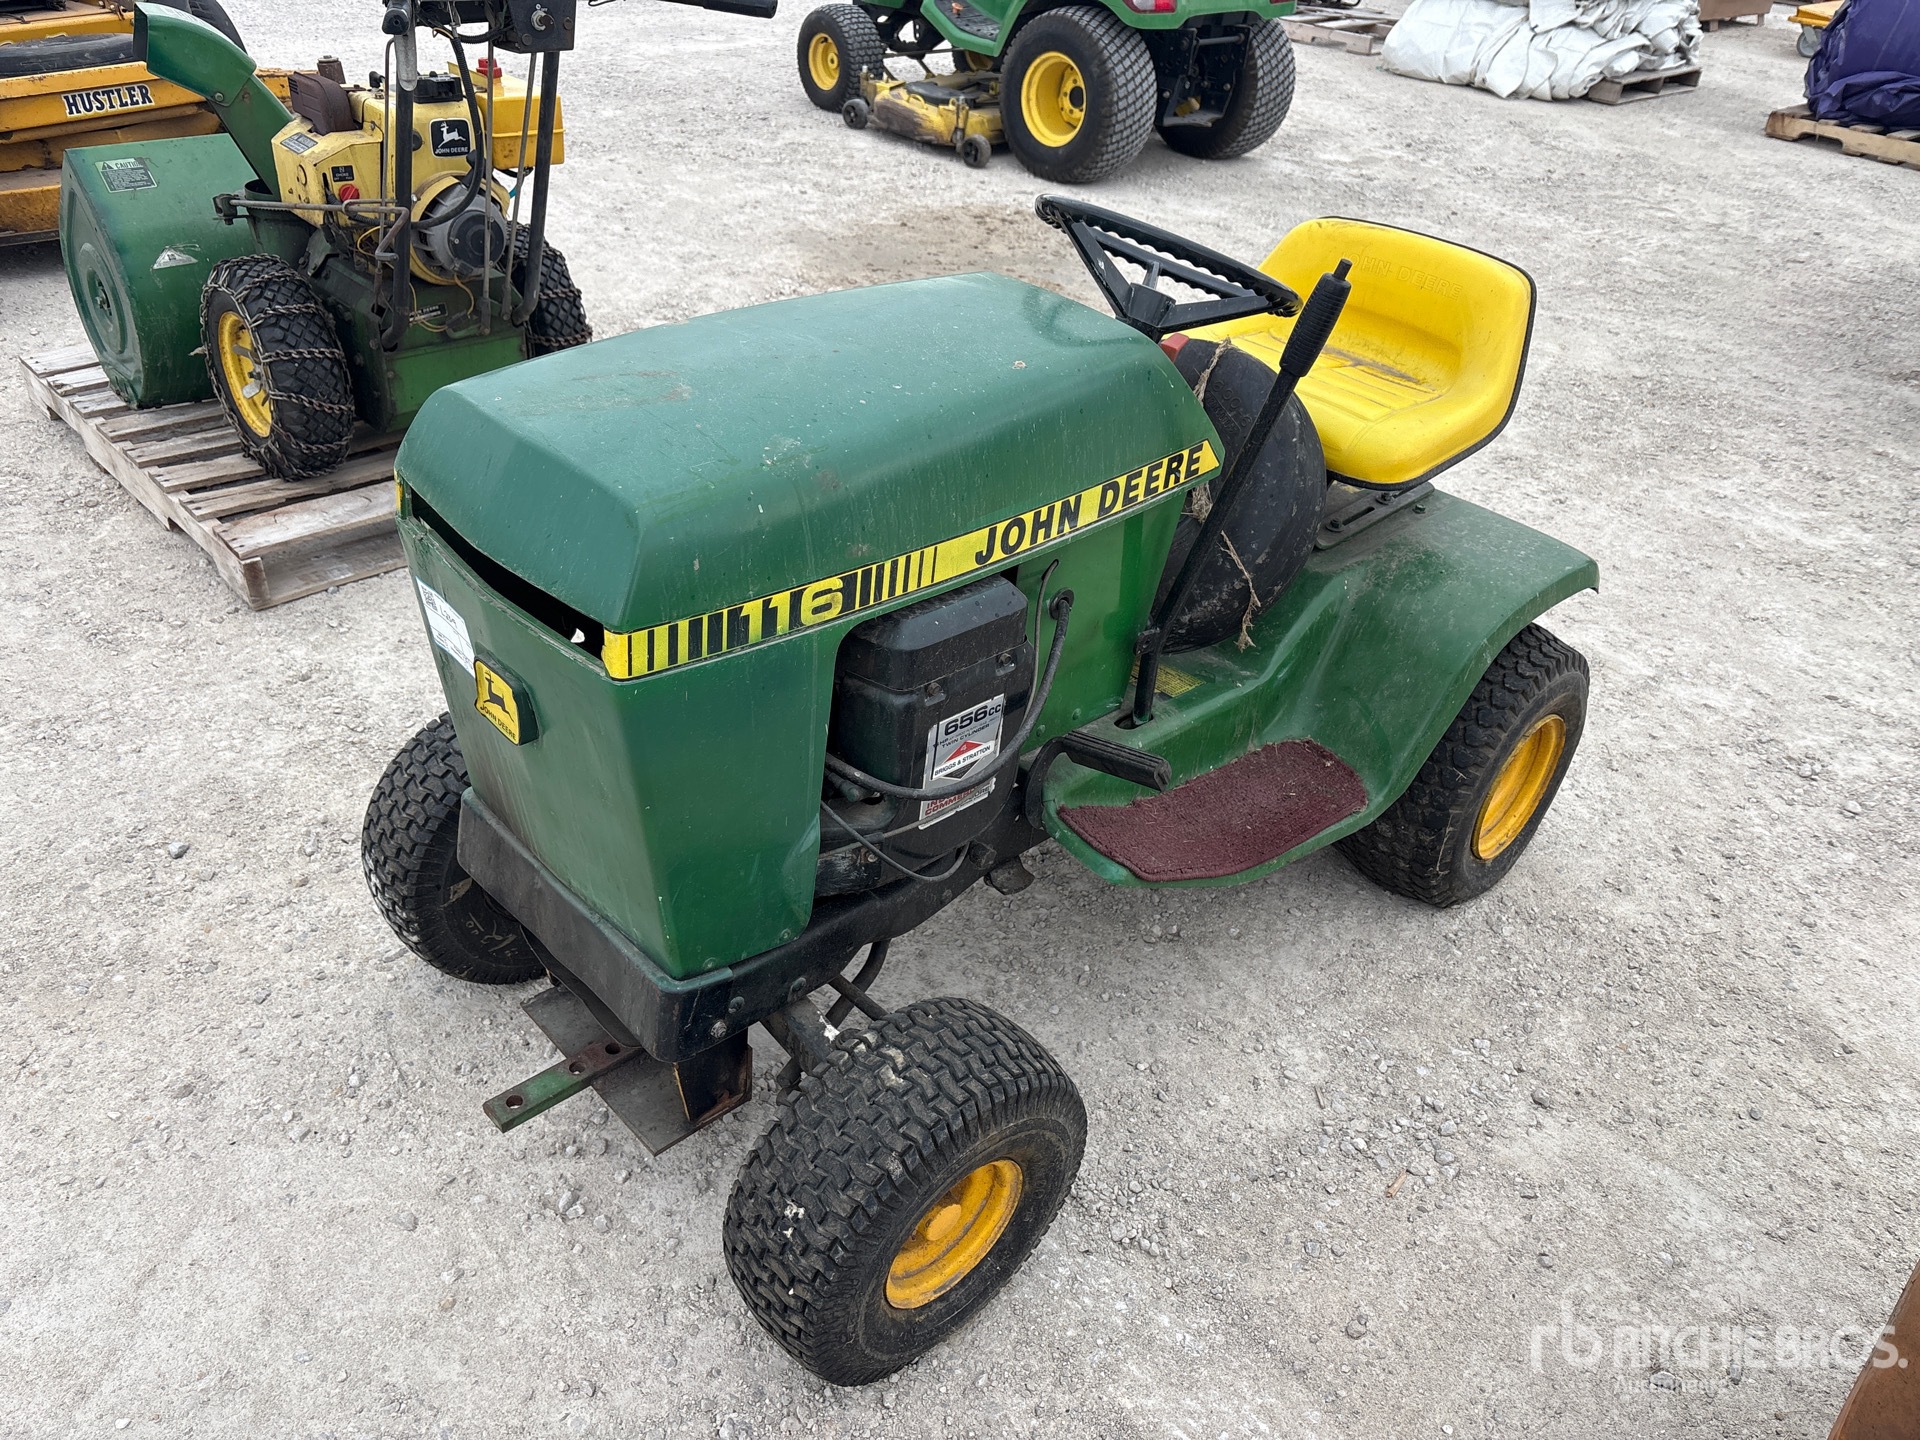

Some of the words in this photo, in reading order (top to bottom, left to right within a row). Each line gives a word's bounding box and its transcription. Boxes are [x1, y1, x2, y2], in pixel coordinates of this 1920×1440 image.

[63, 85, 154, 115] HUSTLER
[1397, 265, 1462, 300] DEERE
[741, 579, 844, 644] 116
[975, 508, 1082, 567] JOHN
[1097, 448, 1204, 517] DEERE
[480, 704, 497, 722] JOHN
[497, 718, 516, 740] DEERE
[941, 737, 959, 749] TWIN
[960, 723, 990, 741] CYLINDER
[934, 760, 957, 777] BRIGGS
[962, 744, 991, 764] STRATTON
